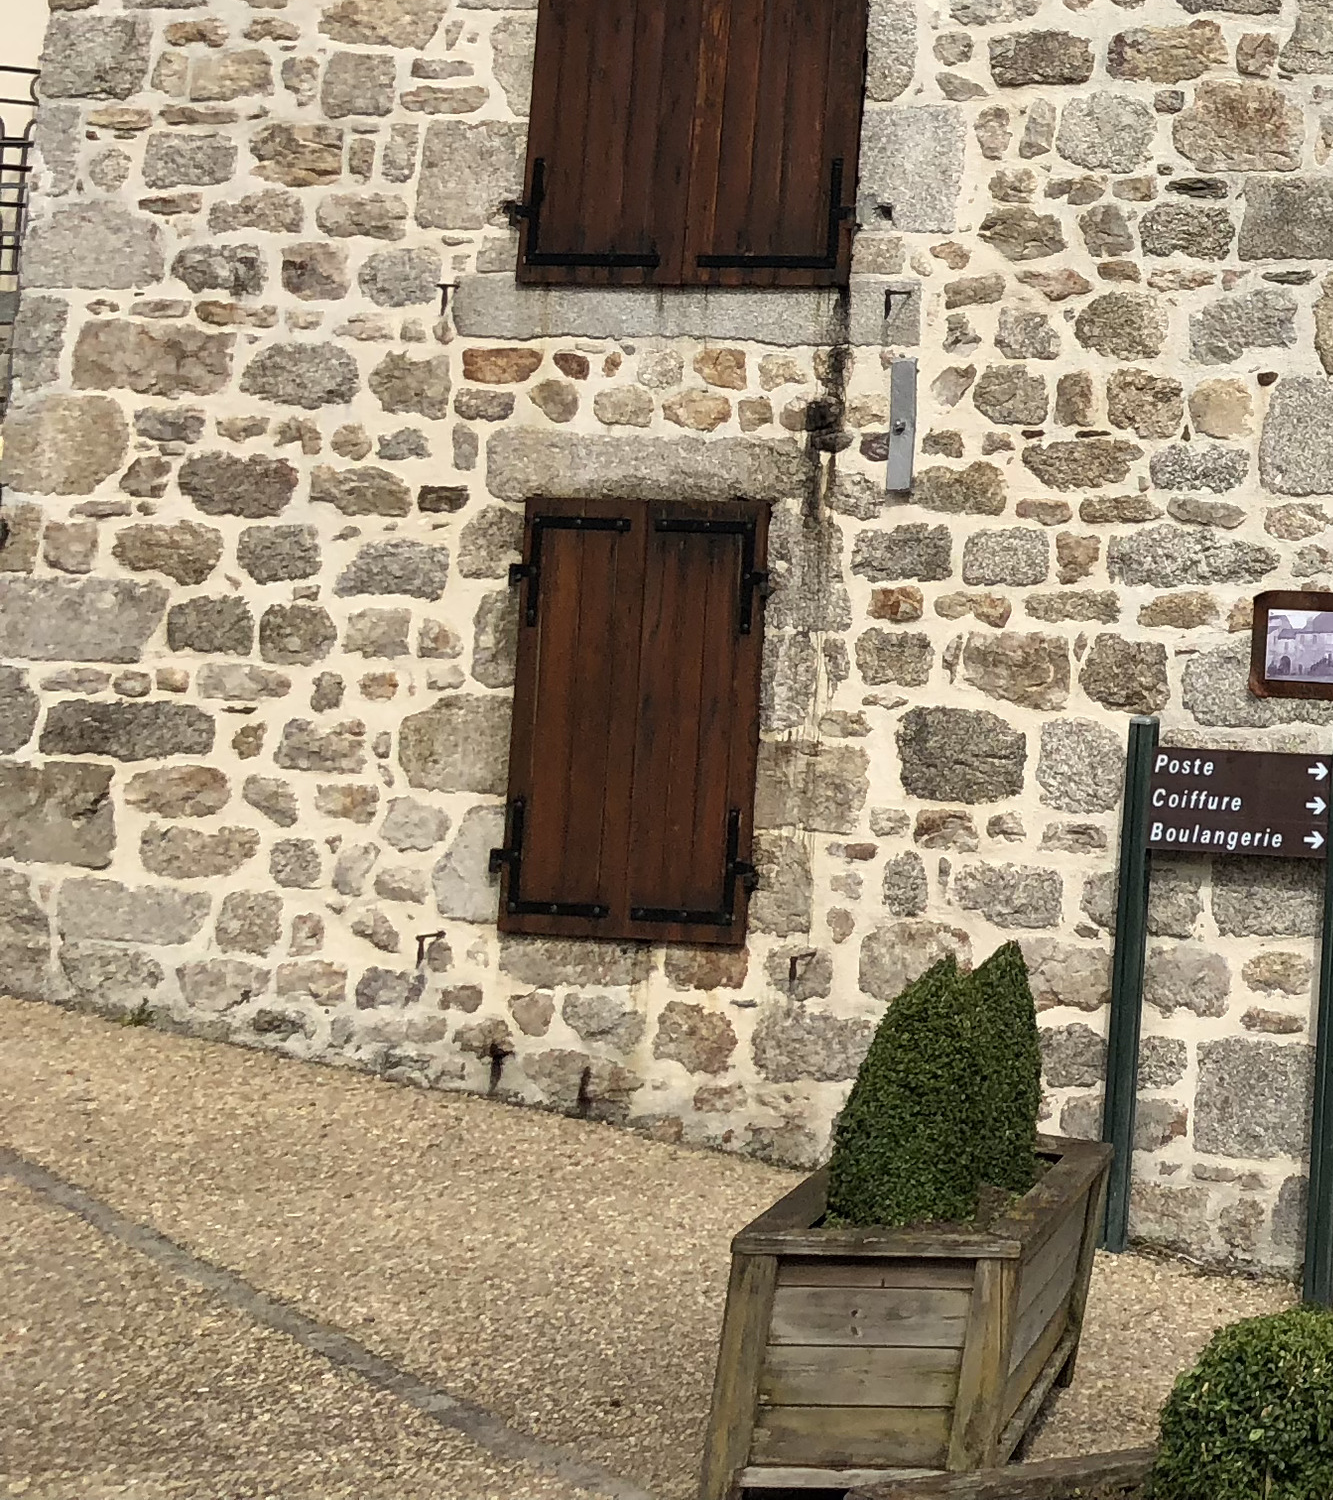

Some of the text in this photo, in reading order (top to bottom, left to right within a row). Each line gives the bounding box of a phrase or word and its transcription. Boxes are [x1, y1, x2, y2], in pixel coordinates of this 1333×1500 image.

[1154, 754, 1214, 776] Poste
[1152, 788, 1242, 812] Coiffure
[1150, 822, 1283, 850] Boulangerie
